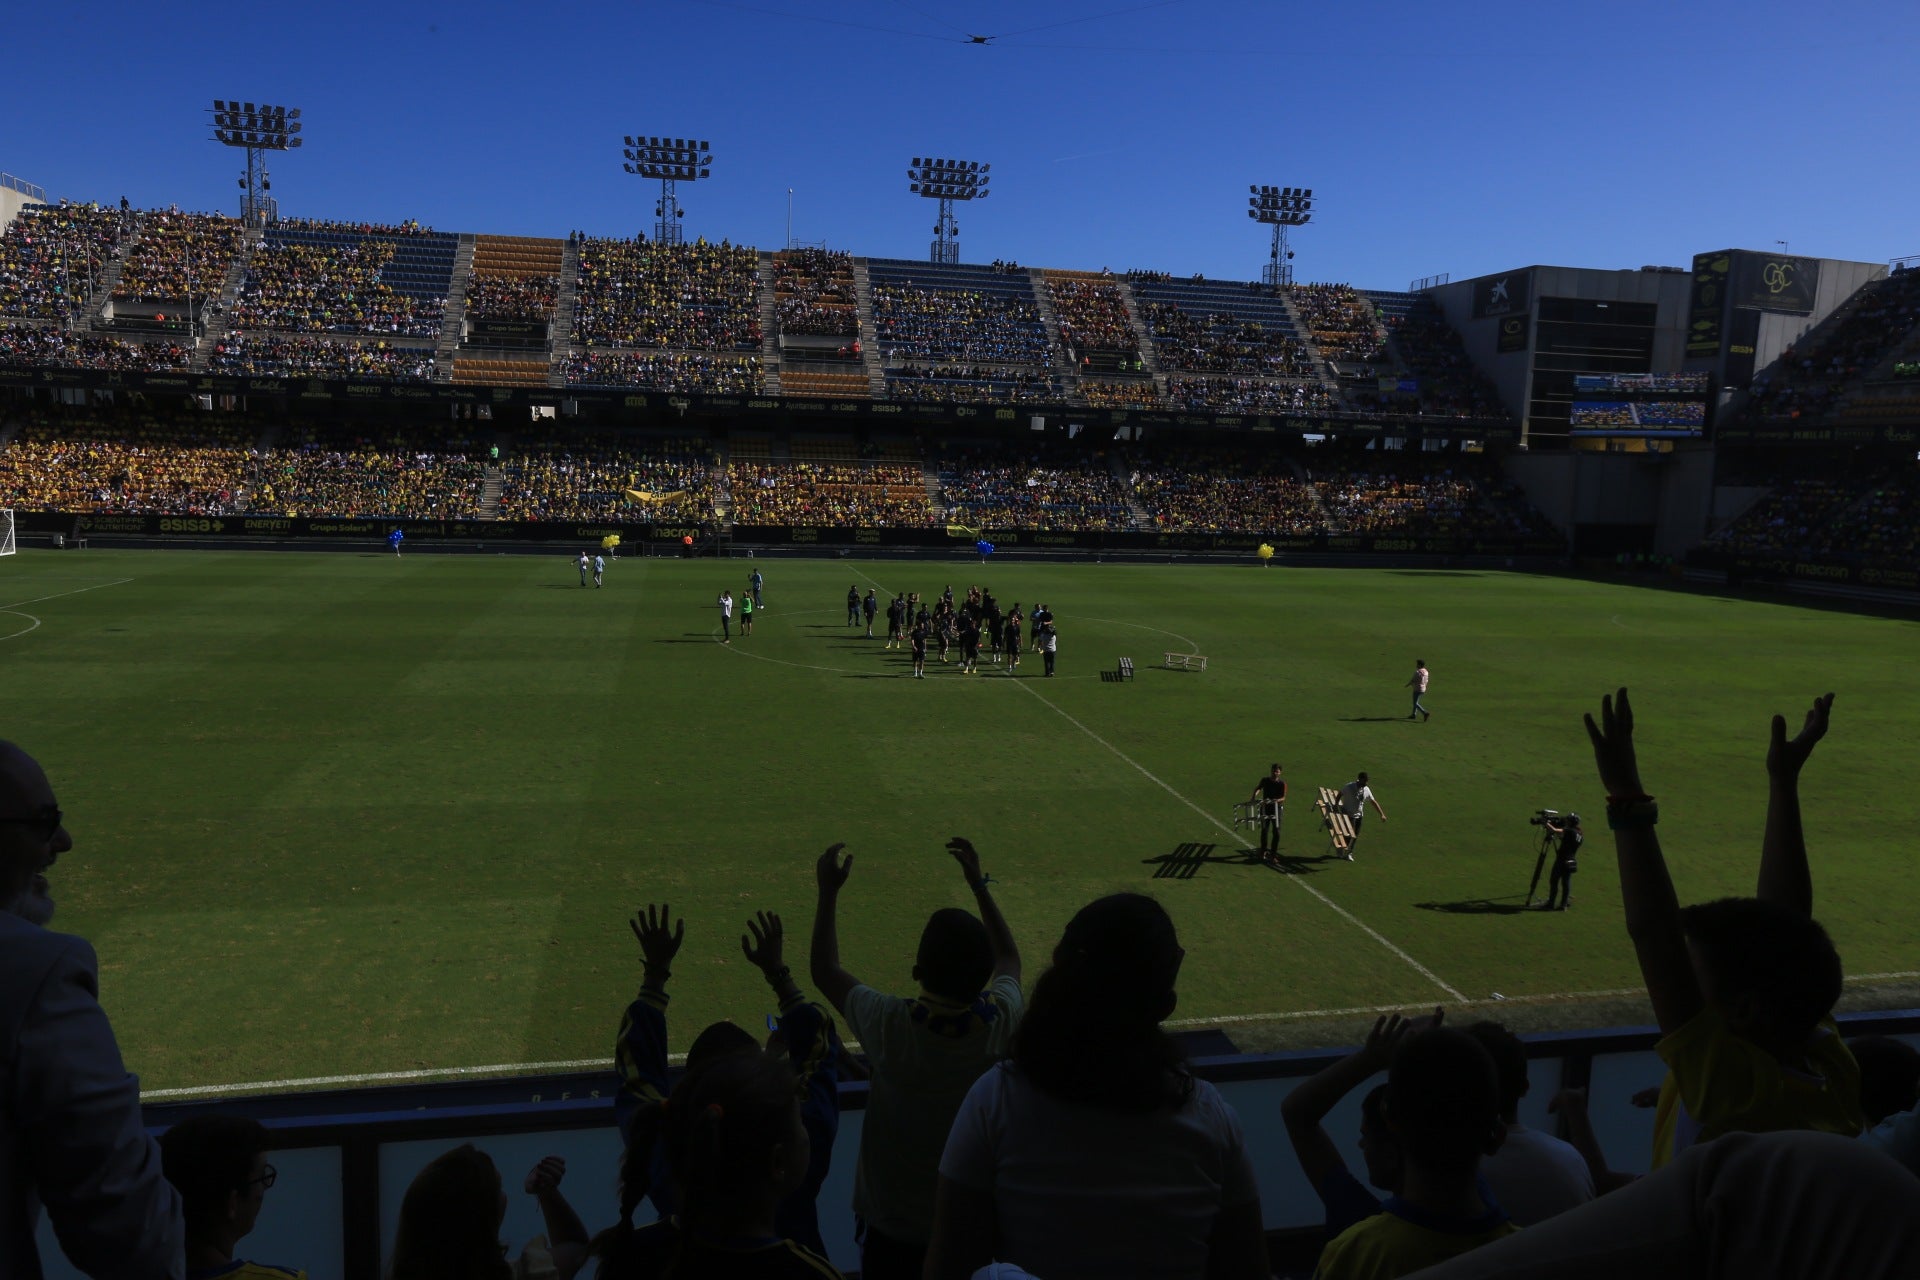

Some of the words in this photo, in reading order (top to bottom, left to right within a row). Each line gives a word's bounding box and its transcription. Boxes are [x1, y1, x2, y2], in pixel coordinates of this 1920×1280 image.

[785, 402, 825, 411] Ayuntamiento
[965, 407, 977, 416] bp
[244, 519, 291, 530] ENERYETI
[309, 523, 337, 532] Grupo
[577, 528, 624, 537] Cruzcampo
[1795, 563, 1848, 579] macron
